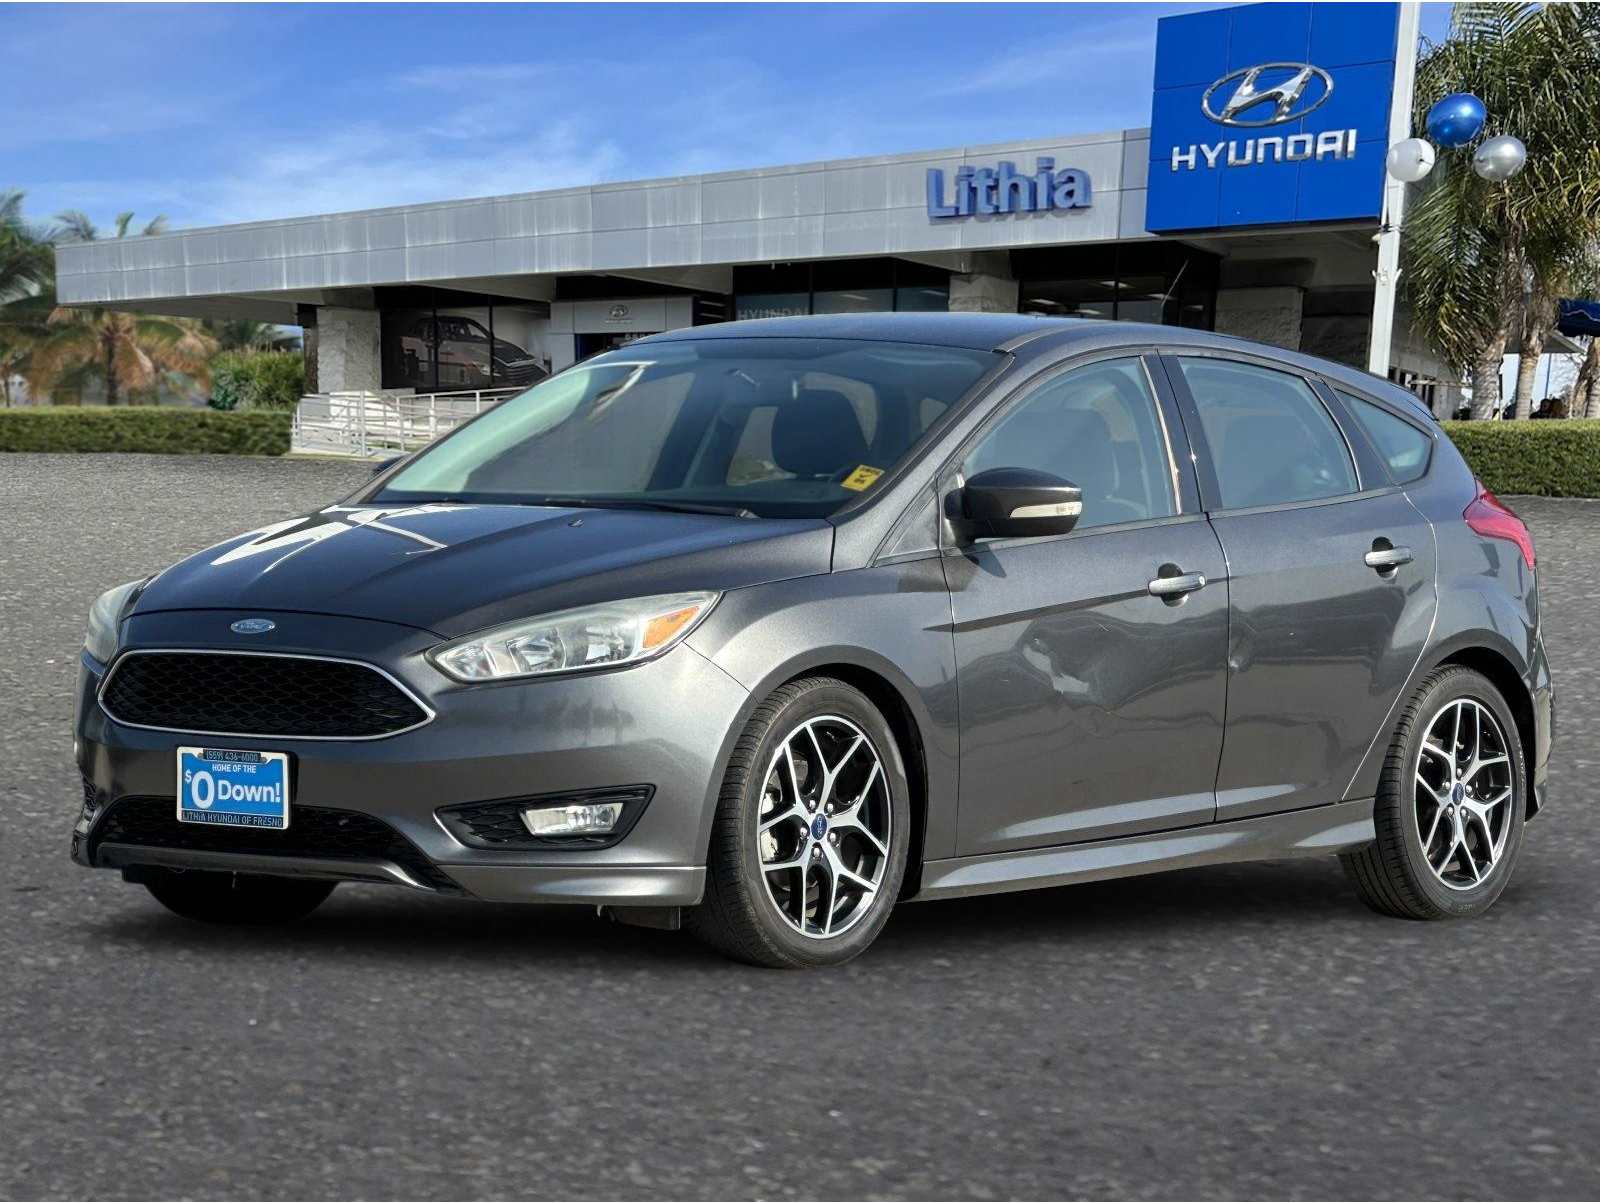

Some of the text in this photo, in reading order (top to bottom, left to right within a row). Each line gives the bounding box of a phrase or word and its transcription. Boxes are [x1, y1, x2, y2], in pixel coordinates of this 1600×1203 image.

[1171, 128, 1357, 172] HYUNDAI
[926, 156, 1092, 219] Lithia
[212, 764, 257, 774] HOME OF THE
[217, 780, 281, 803] Down!
[182, 811, 283, 827] LITHIA HYUNDAI OF FRESNO
